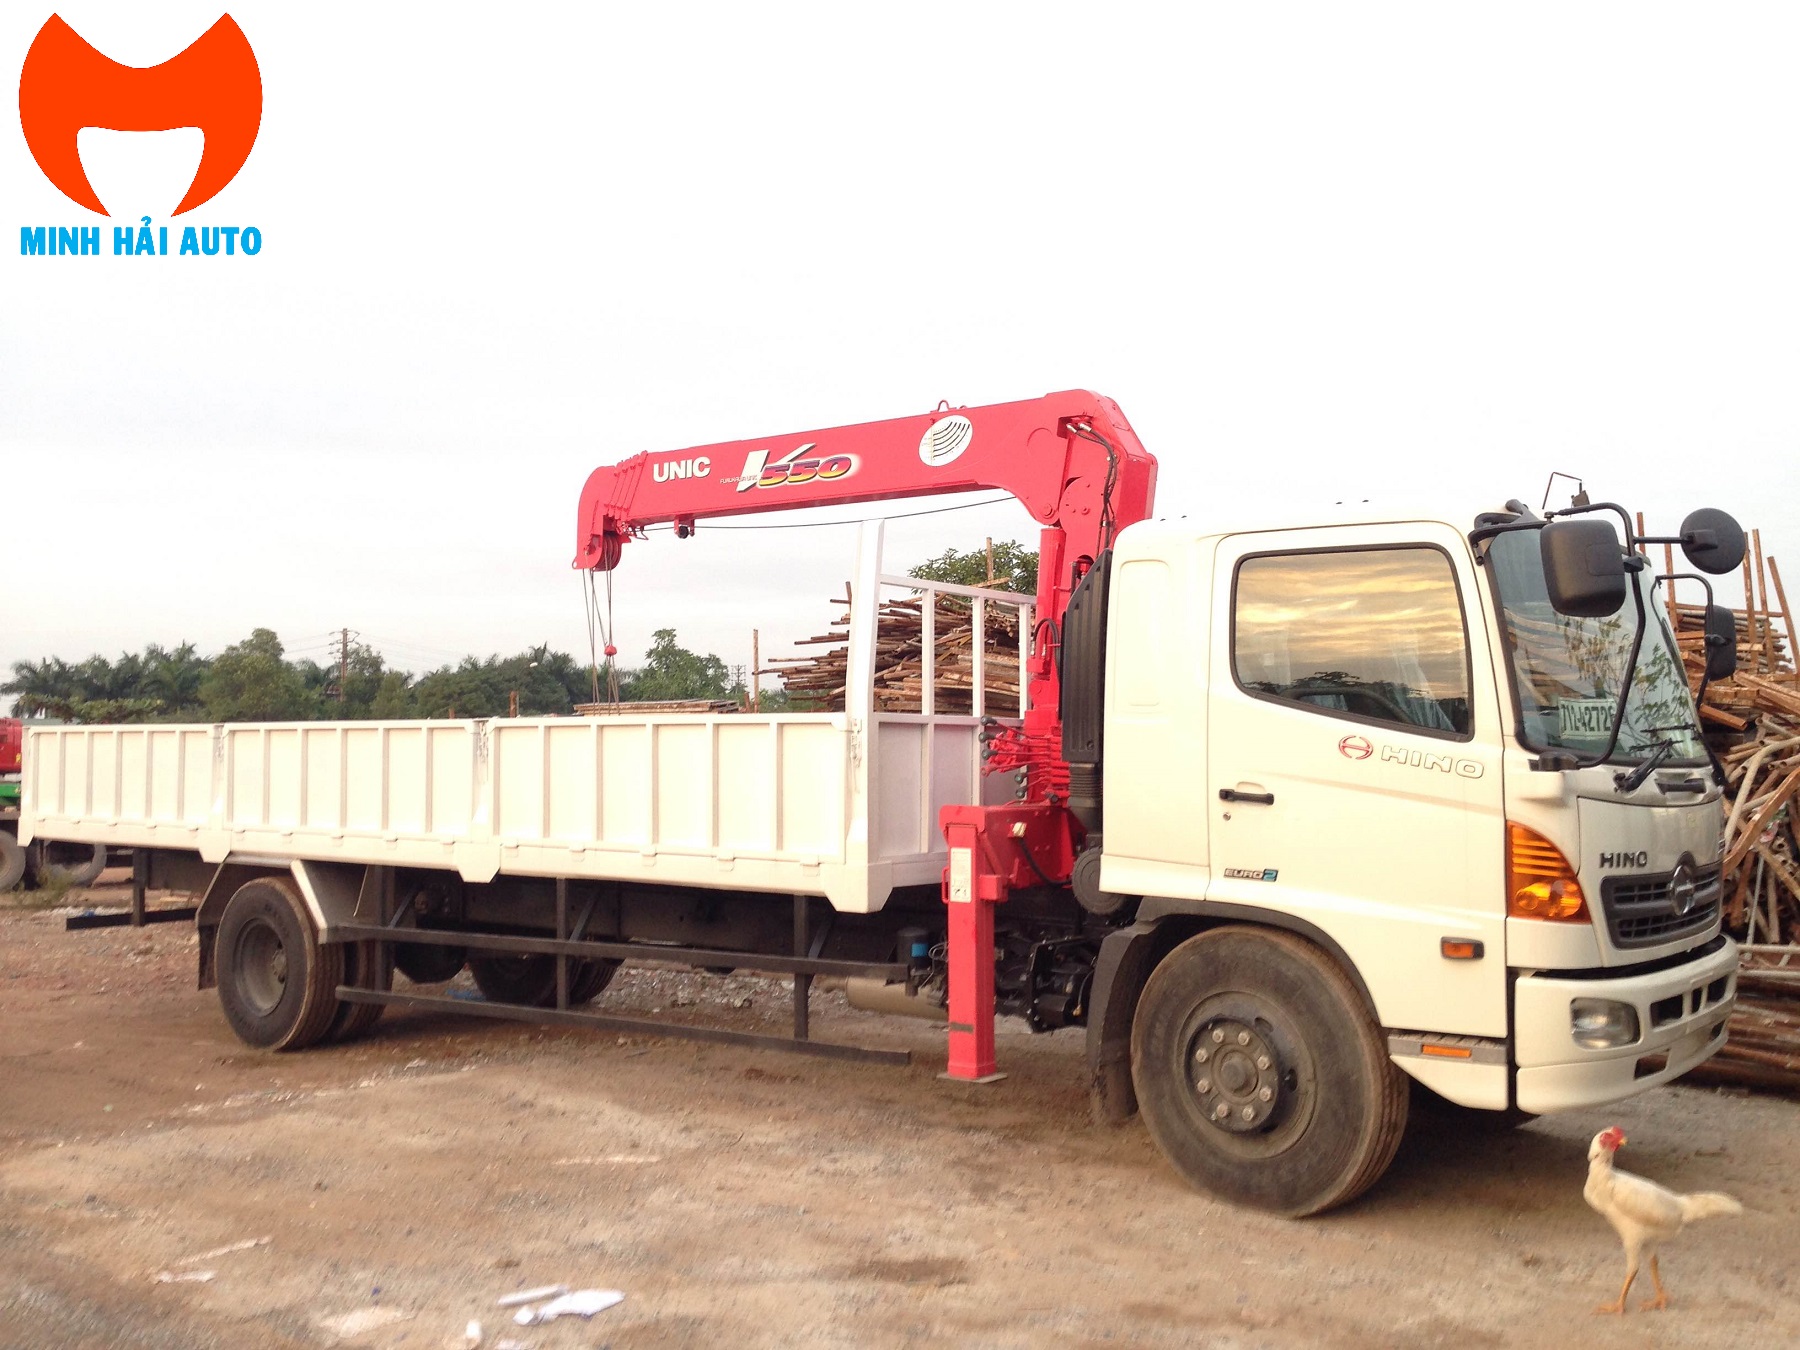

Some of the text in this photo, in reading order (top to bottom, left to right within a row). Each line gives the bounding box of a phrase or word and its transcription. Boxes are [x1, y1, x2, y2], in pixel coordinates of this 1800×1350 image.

[653, 456, 711, 483] UNIC
[1381, 744, 1485, 780] HINO
[1599, 851, 1648, 869] HINO
